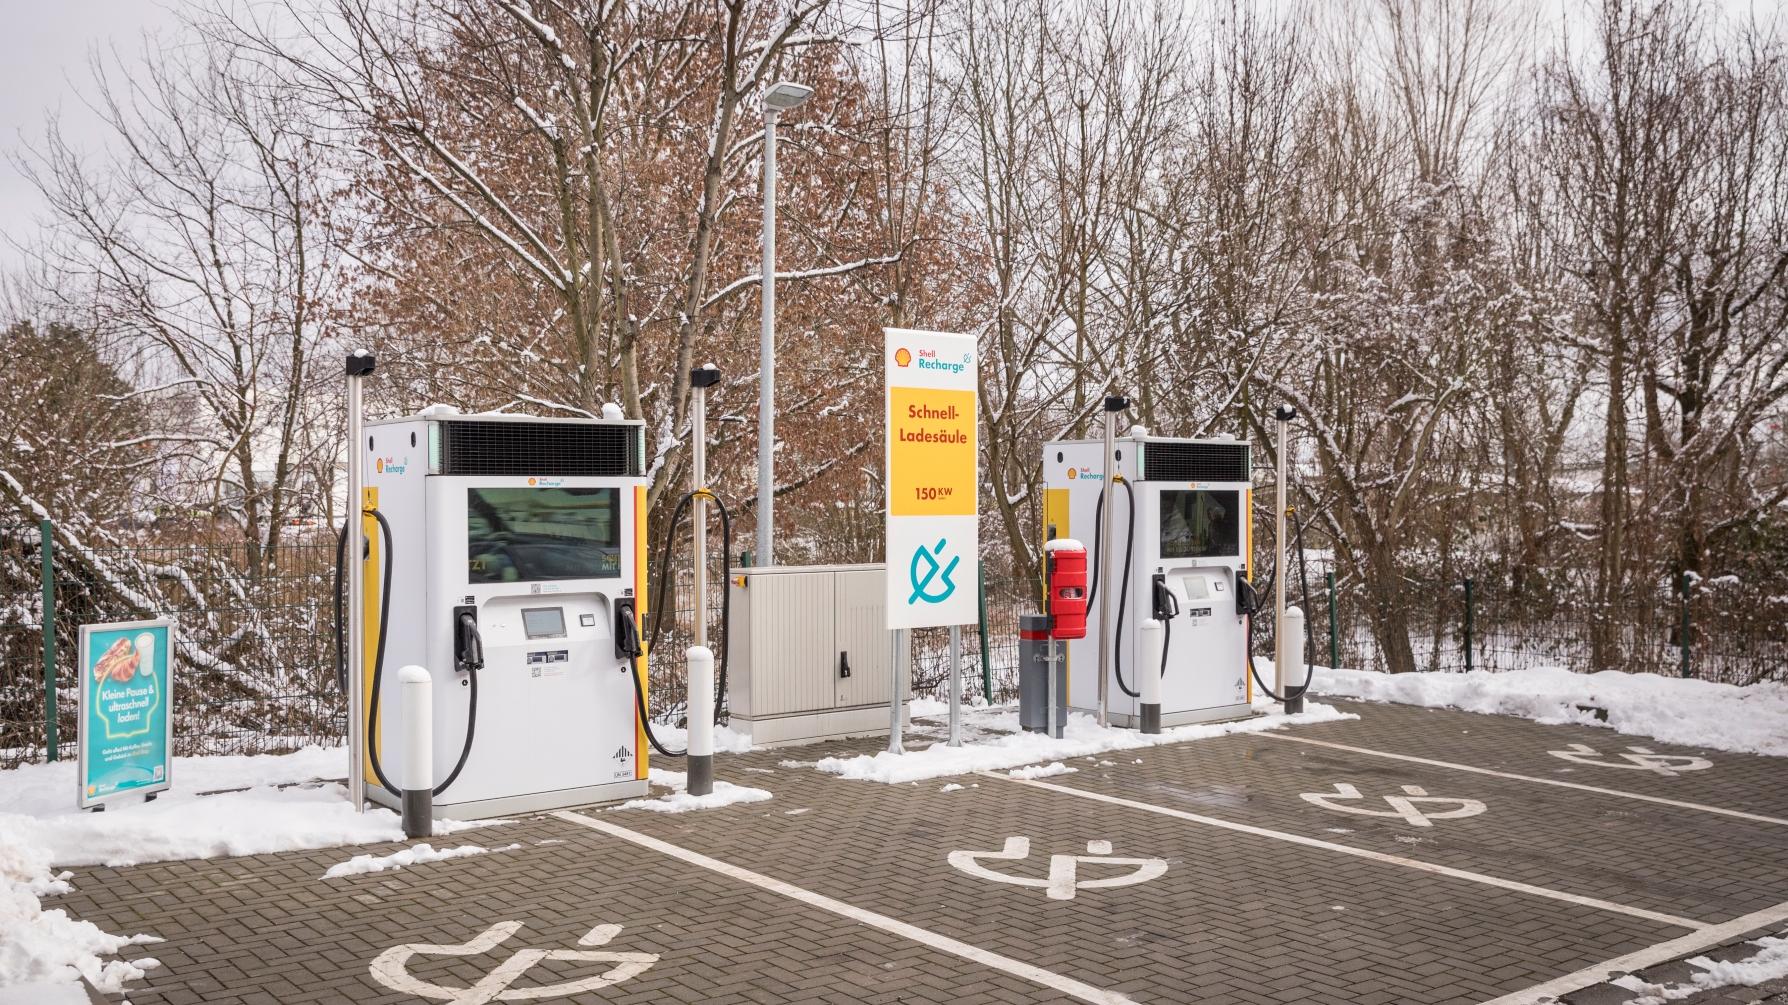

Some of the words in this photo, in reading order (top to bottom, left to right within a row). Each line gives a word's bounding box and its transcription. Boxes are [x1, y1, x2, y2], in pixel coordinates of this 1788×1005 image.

[919, 349, 936, 358] Shell
[918, 358, 965, 374] Recharge
[908, 404, 960, 420] Schnell-
[899, 427, 968, 445] Ladesäule
[915, 487, 937, 501] 150
[102, 689, 126, 701] Kleine
[126, 687, 148, 698] Pause
[148, 684, 155, 694] &
[108, 696, 150, 712] ultraschnell
[117, 710, 141, 723] laden!
